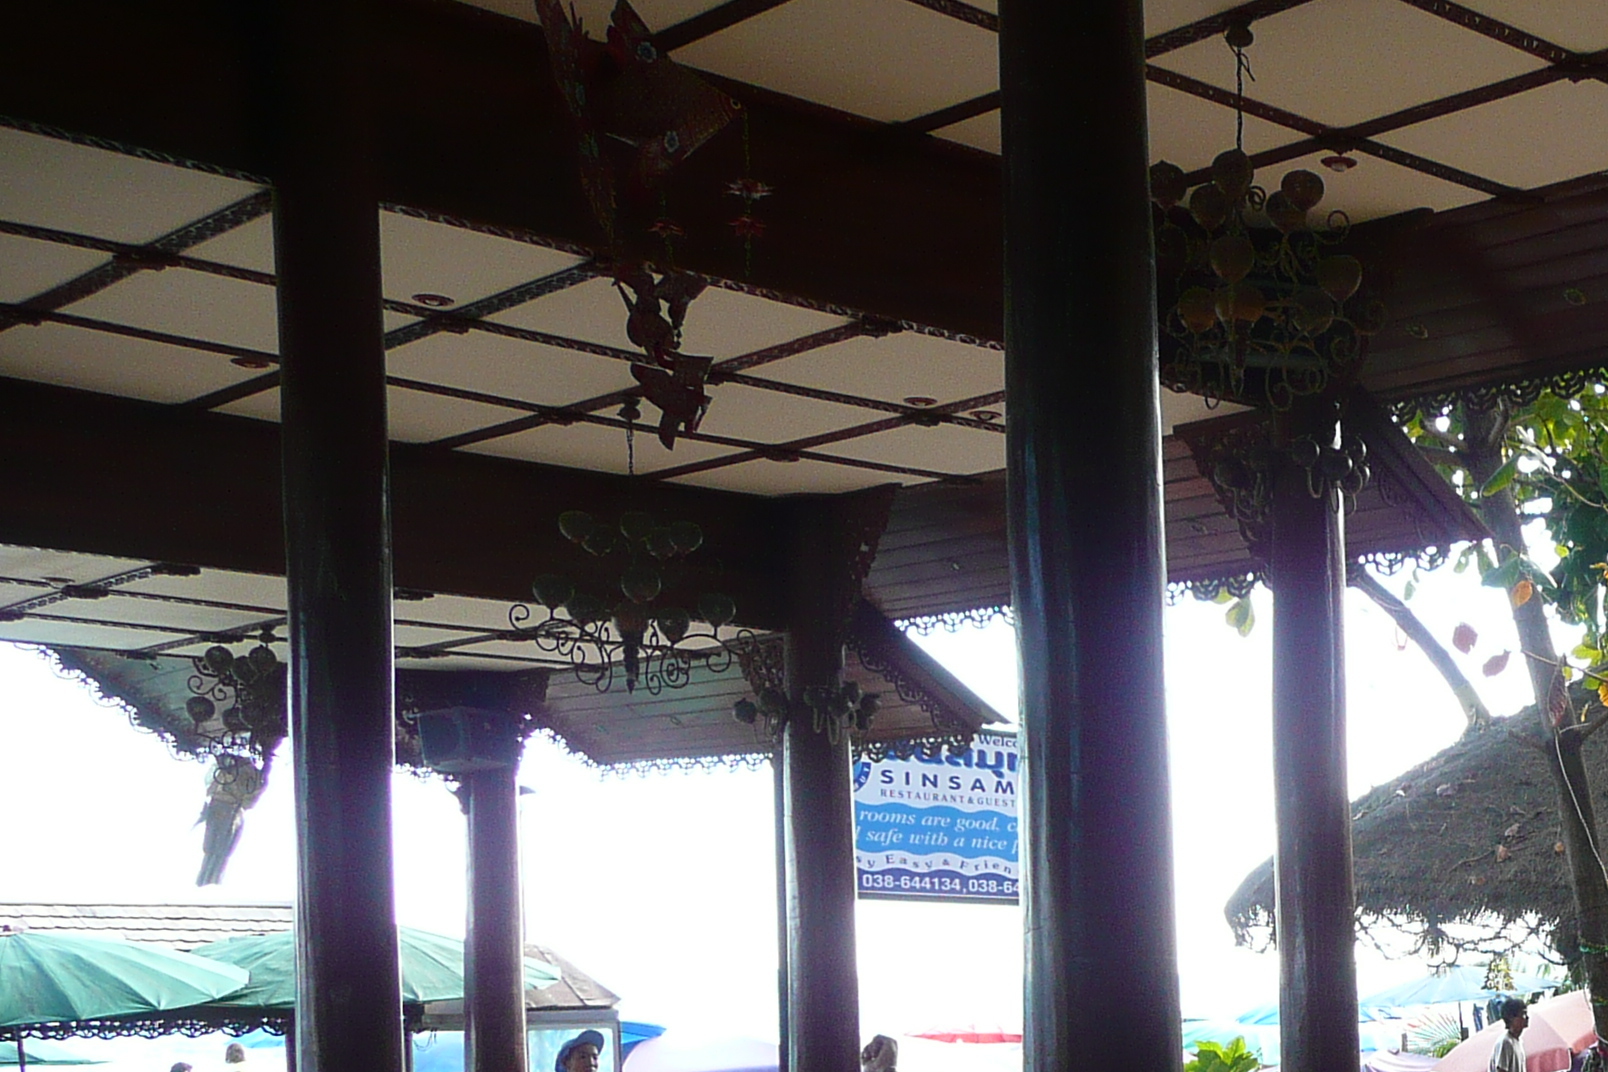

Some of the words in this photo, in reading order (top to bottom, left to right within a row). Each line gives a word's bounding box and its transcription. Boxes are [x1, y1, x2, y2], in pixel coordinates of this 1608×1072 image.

[880, 769, 1015, 794] SINSAM
[860, 810, 915, 824] rooms
[921, 815, 950, 827] are
[866, 828, 902, 846] safe
[909, 831, 948, 847] with
[953, 836, 965, 848] a
[971, 835, 1008, 850] nice
[885, 854, 933, 868] Easy
